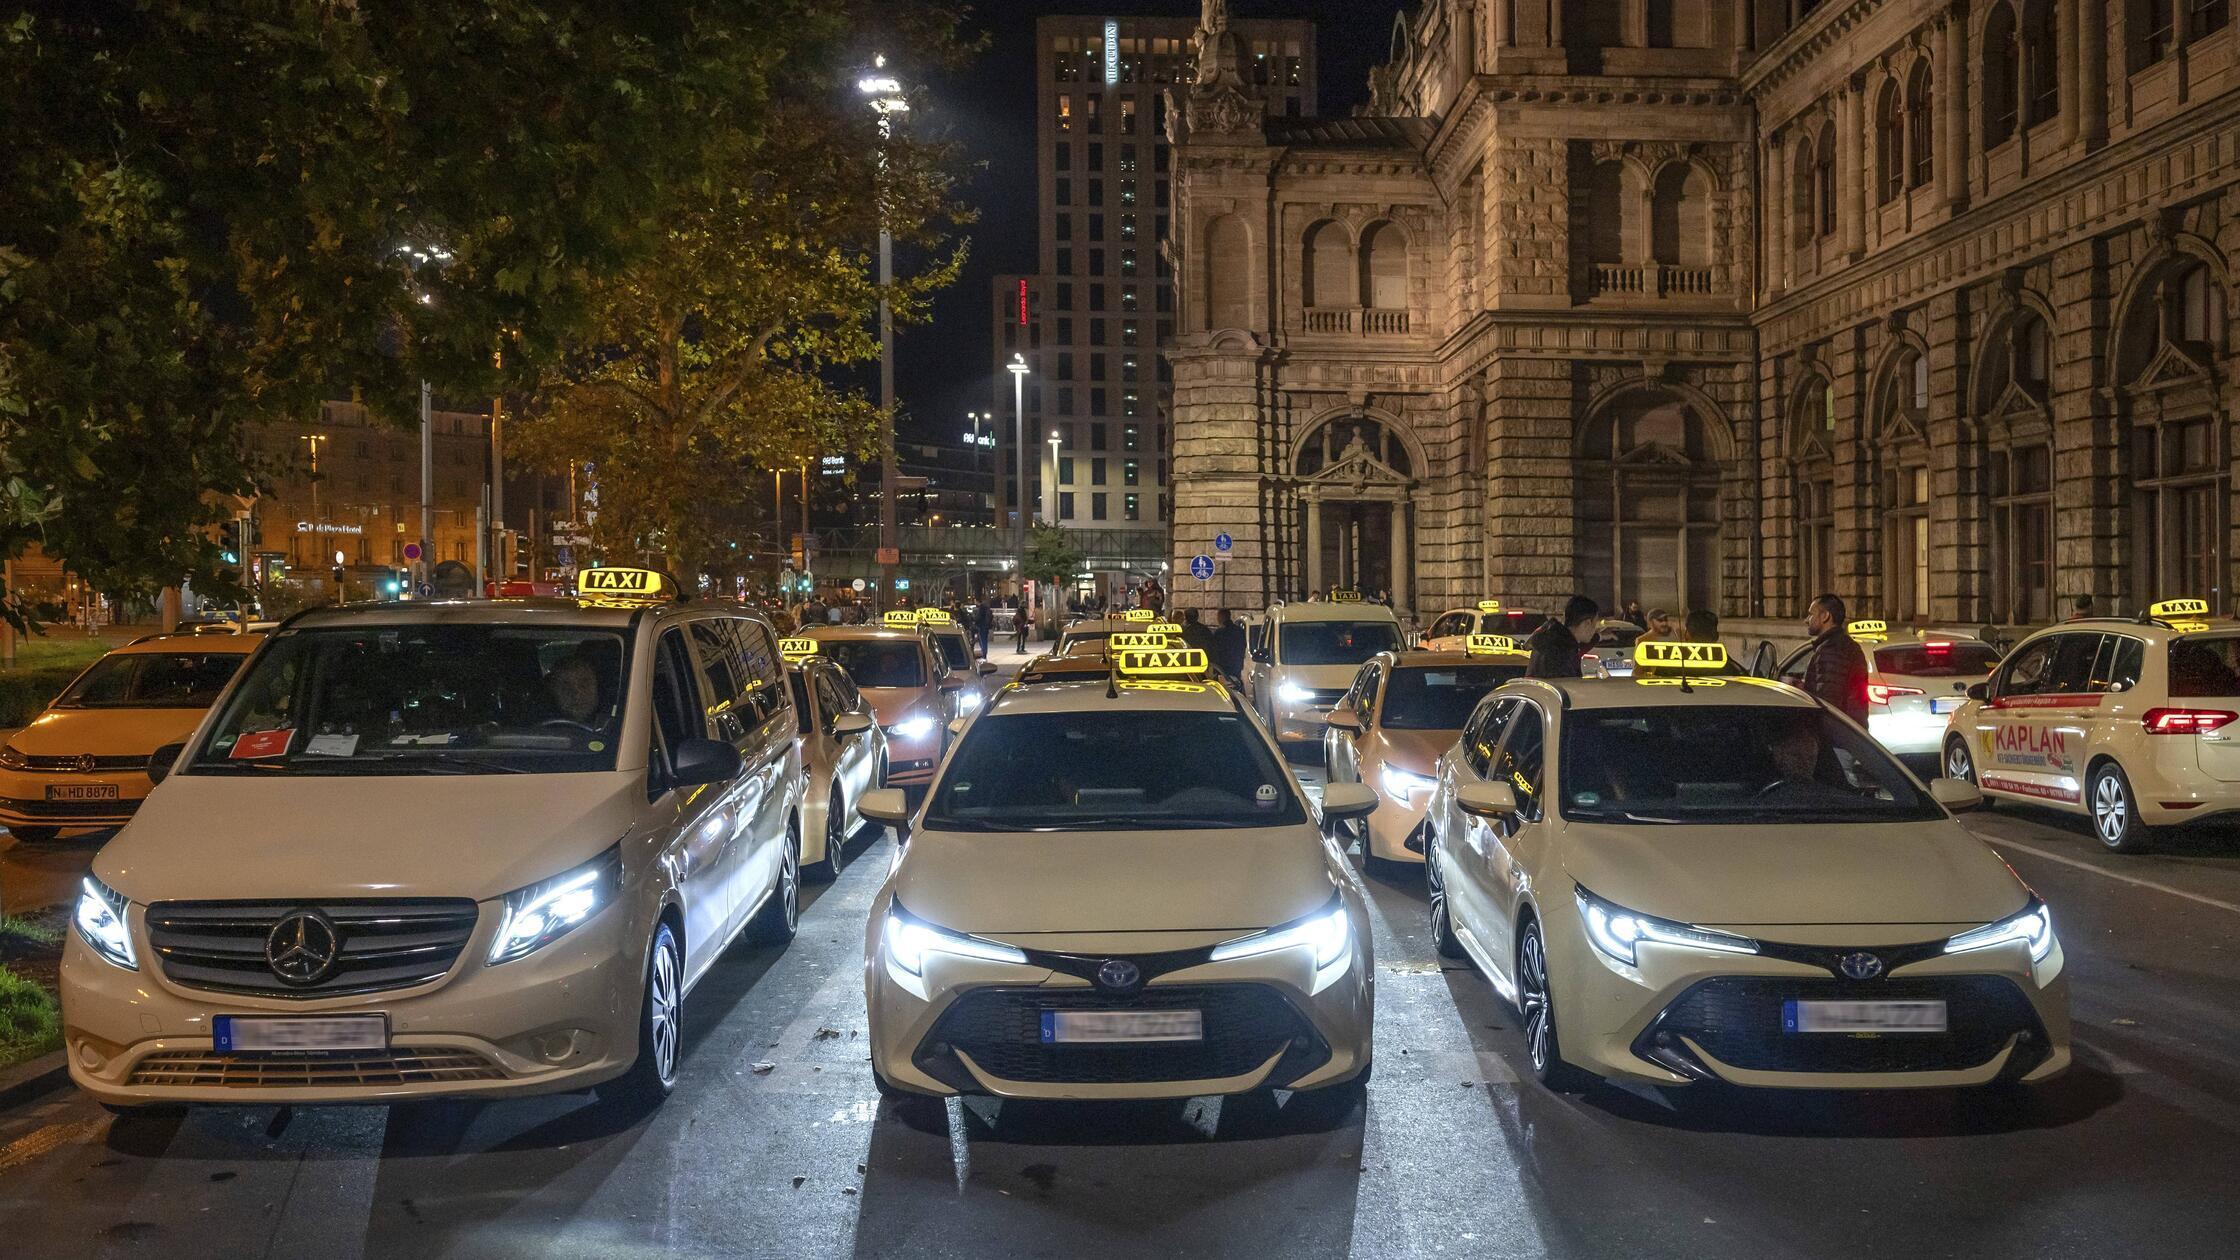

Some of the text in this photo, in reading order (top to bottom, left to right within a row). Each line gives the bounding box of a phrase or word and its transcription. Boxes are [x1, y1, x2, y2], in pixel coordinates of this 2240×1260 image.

[591, 572, 642, 588] TAXI
[1338, 592, 1357, 600] TAXI
[2165, 602, 2198, 612] TAXI
[1119, 635, 1157, 645] TAXI
[1475, 636, 1506, 647] TAXI
[779, 641, 807, 650] TAXI
[1654, 645, 1713, 660] TAXI
[1133, 653, 1191, 667] TAXI
[1996, 725, 2065, 753] KAPLAN
[53, 788, 60, 798] N
[68, 788, 83, 798] HD
[1787, 1020, 1794, 1028] D
[1044, 1029, 1051, 1038] D
